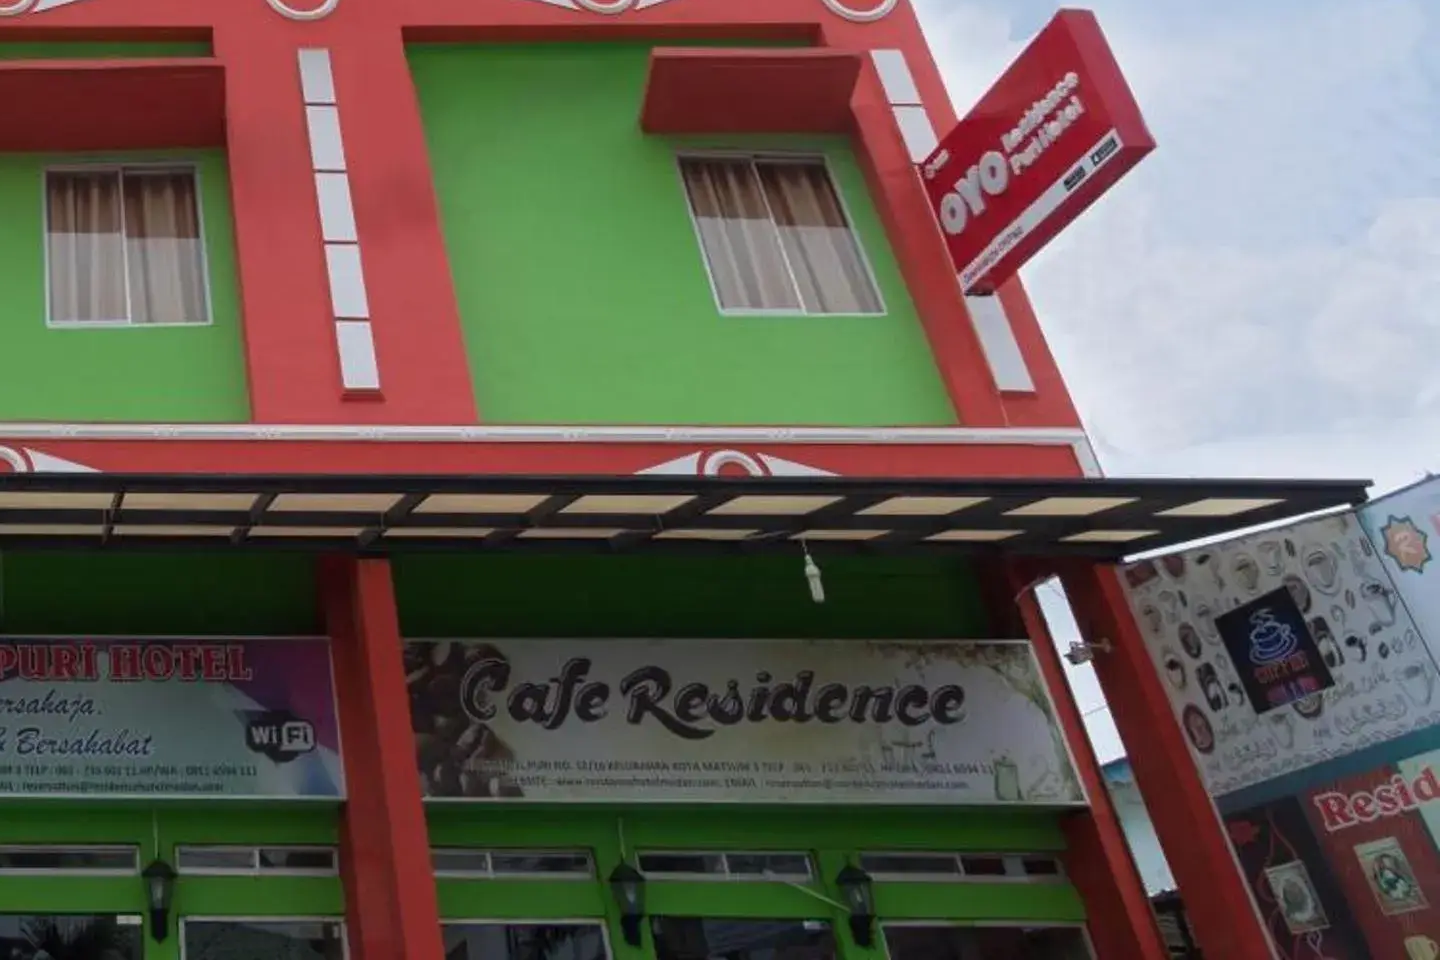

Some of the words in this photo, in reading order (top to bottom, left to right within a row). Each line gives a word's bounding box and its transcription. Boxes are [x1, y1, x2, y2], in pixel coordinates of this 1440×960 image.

[940, 151, 1009, 234] OYO
[109, 643, 253, 682] HOTEL
[461, 657, 609, 730] Cafe
[620, 665, 965, 740] Residence
[16, 727, 153, 756] Bersahabat
